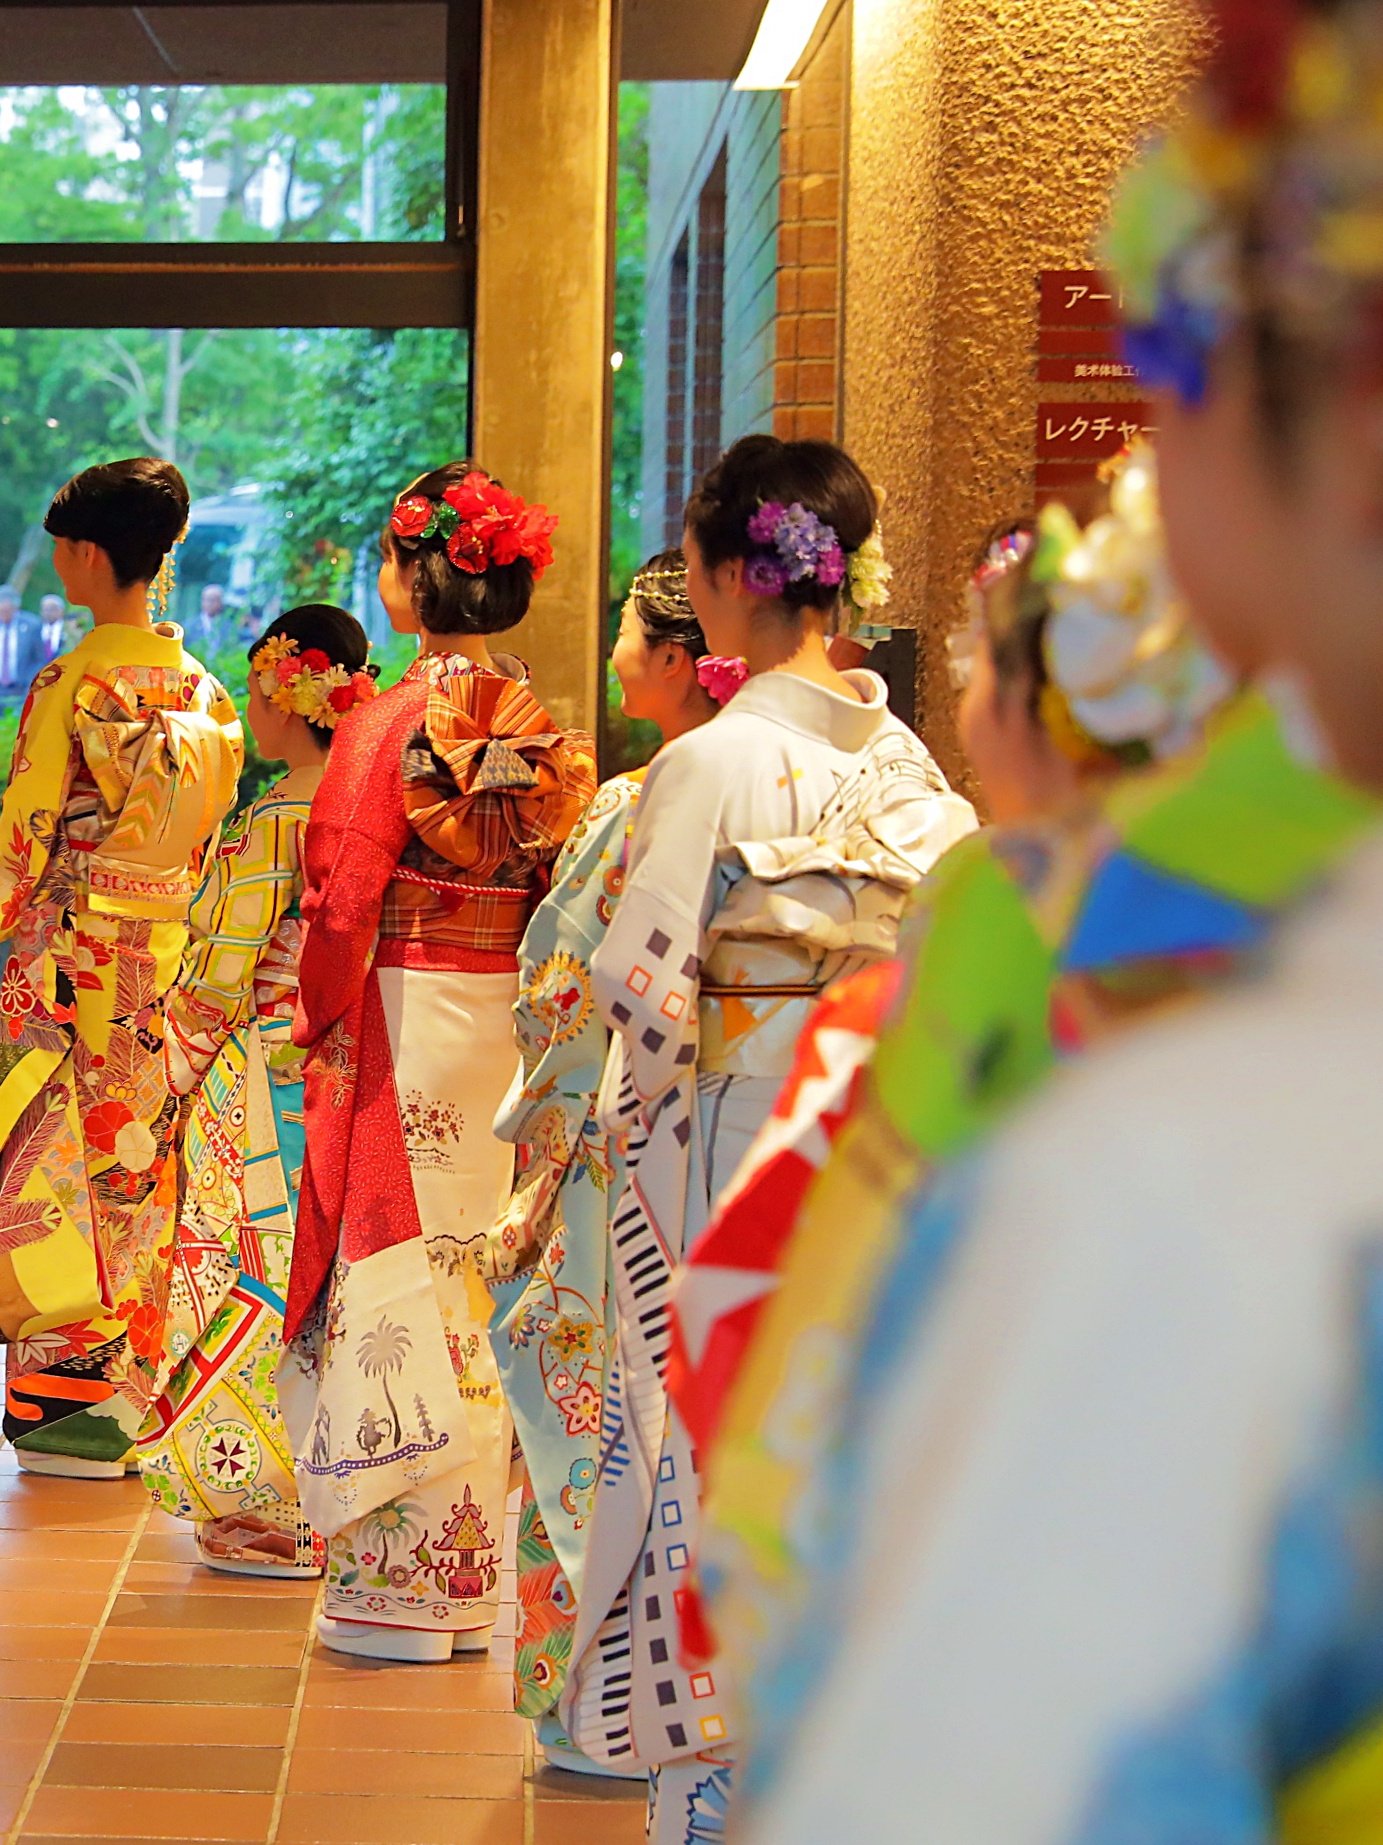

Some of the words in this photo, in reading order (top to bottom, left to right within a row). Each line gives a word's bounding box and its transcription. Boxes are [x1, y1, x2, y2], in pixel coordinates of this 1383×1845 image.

[1074, 363, 1139, 377] 美术体验工
[1045, 416, 1161, 442] レクチャー
